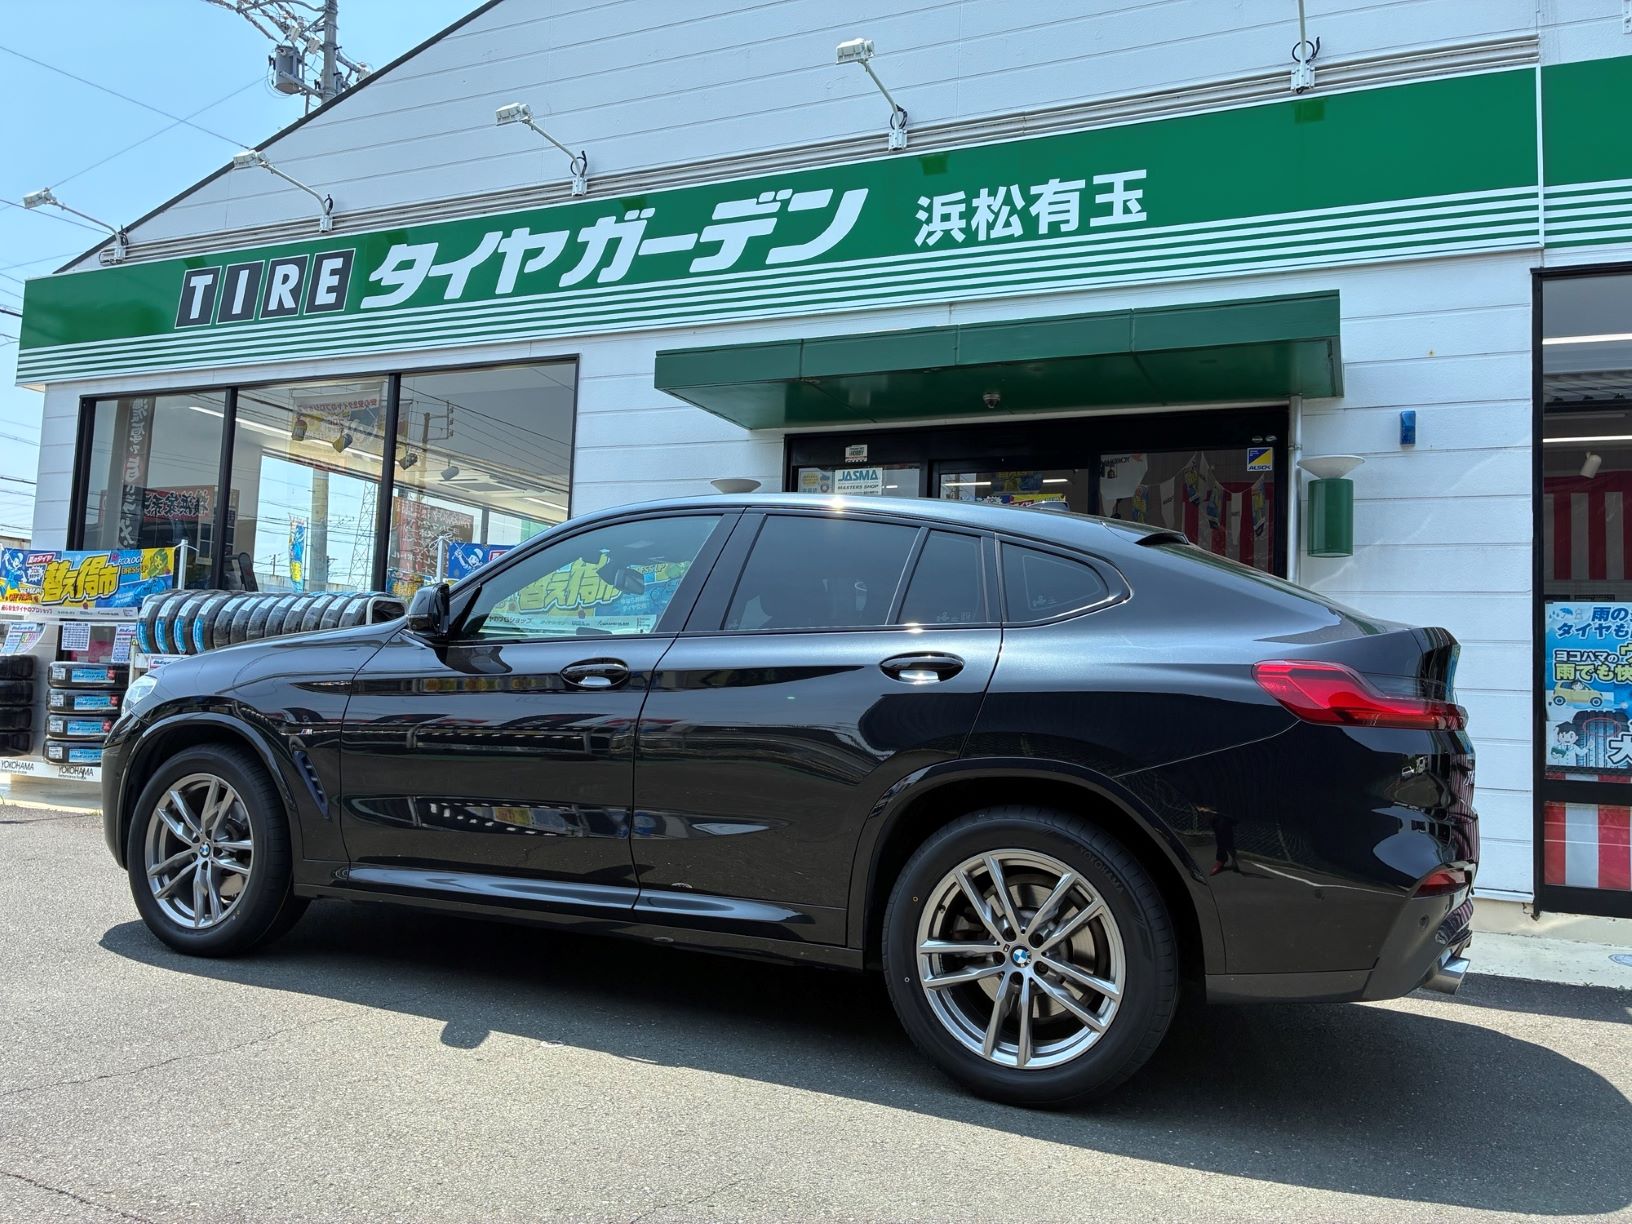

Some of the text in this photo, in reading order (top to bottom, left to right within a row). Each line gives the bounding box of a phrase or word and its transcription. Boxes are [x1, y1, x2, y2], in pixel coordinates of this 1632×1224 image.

[189, 169, 1148, 319] TIRE タイヤガーデン 浜松有玉
[838, 469, 879, 482] JASMA
[43, 555, 120, 603] 替え得市
[1592, 607, 1632, 621] 雨の
[1557, 622, 1632, 638] タイヤも
[1556, 650, 1618, 663] ヨコハマの
[1, 760, 34, 771] YOKOHAMA
[58, 766, 94, 776] YOKOHAMA
